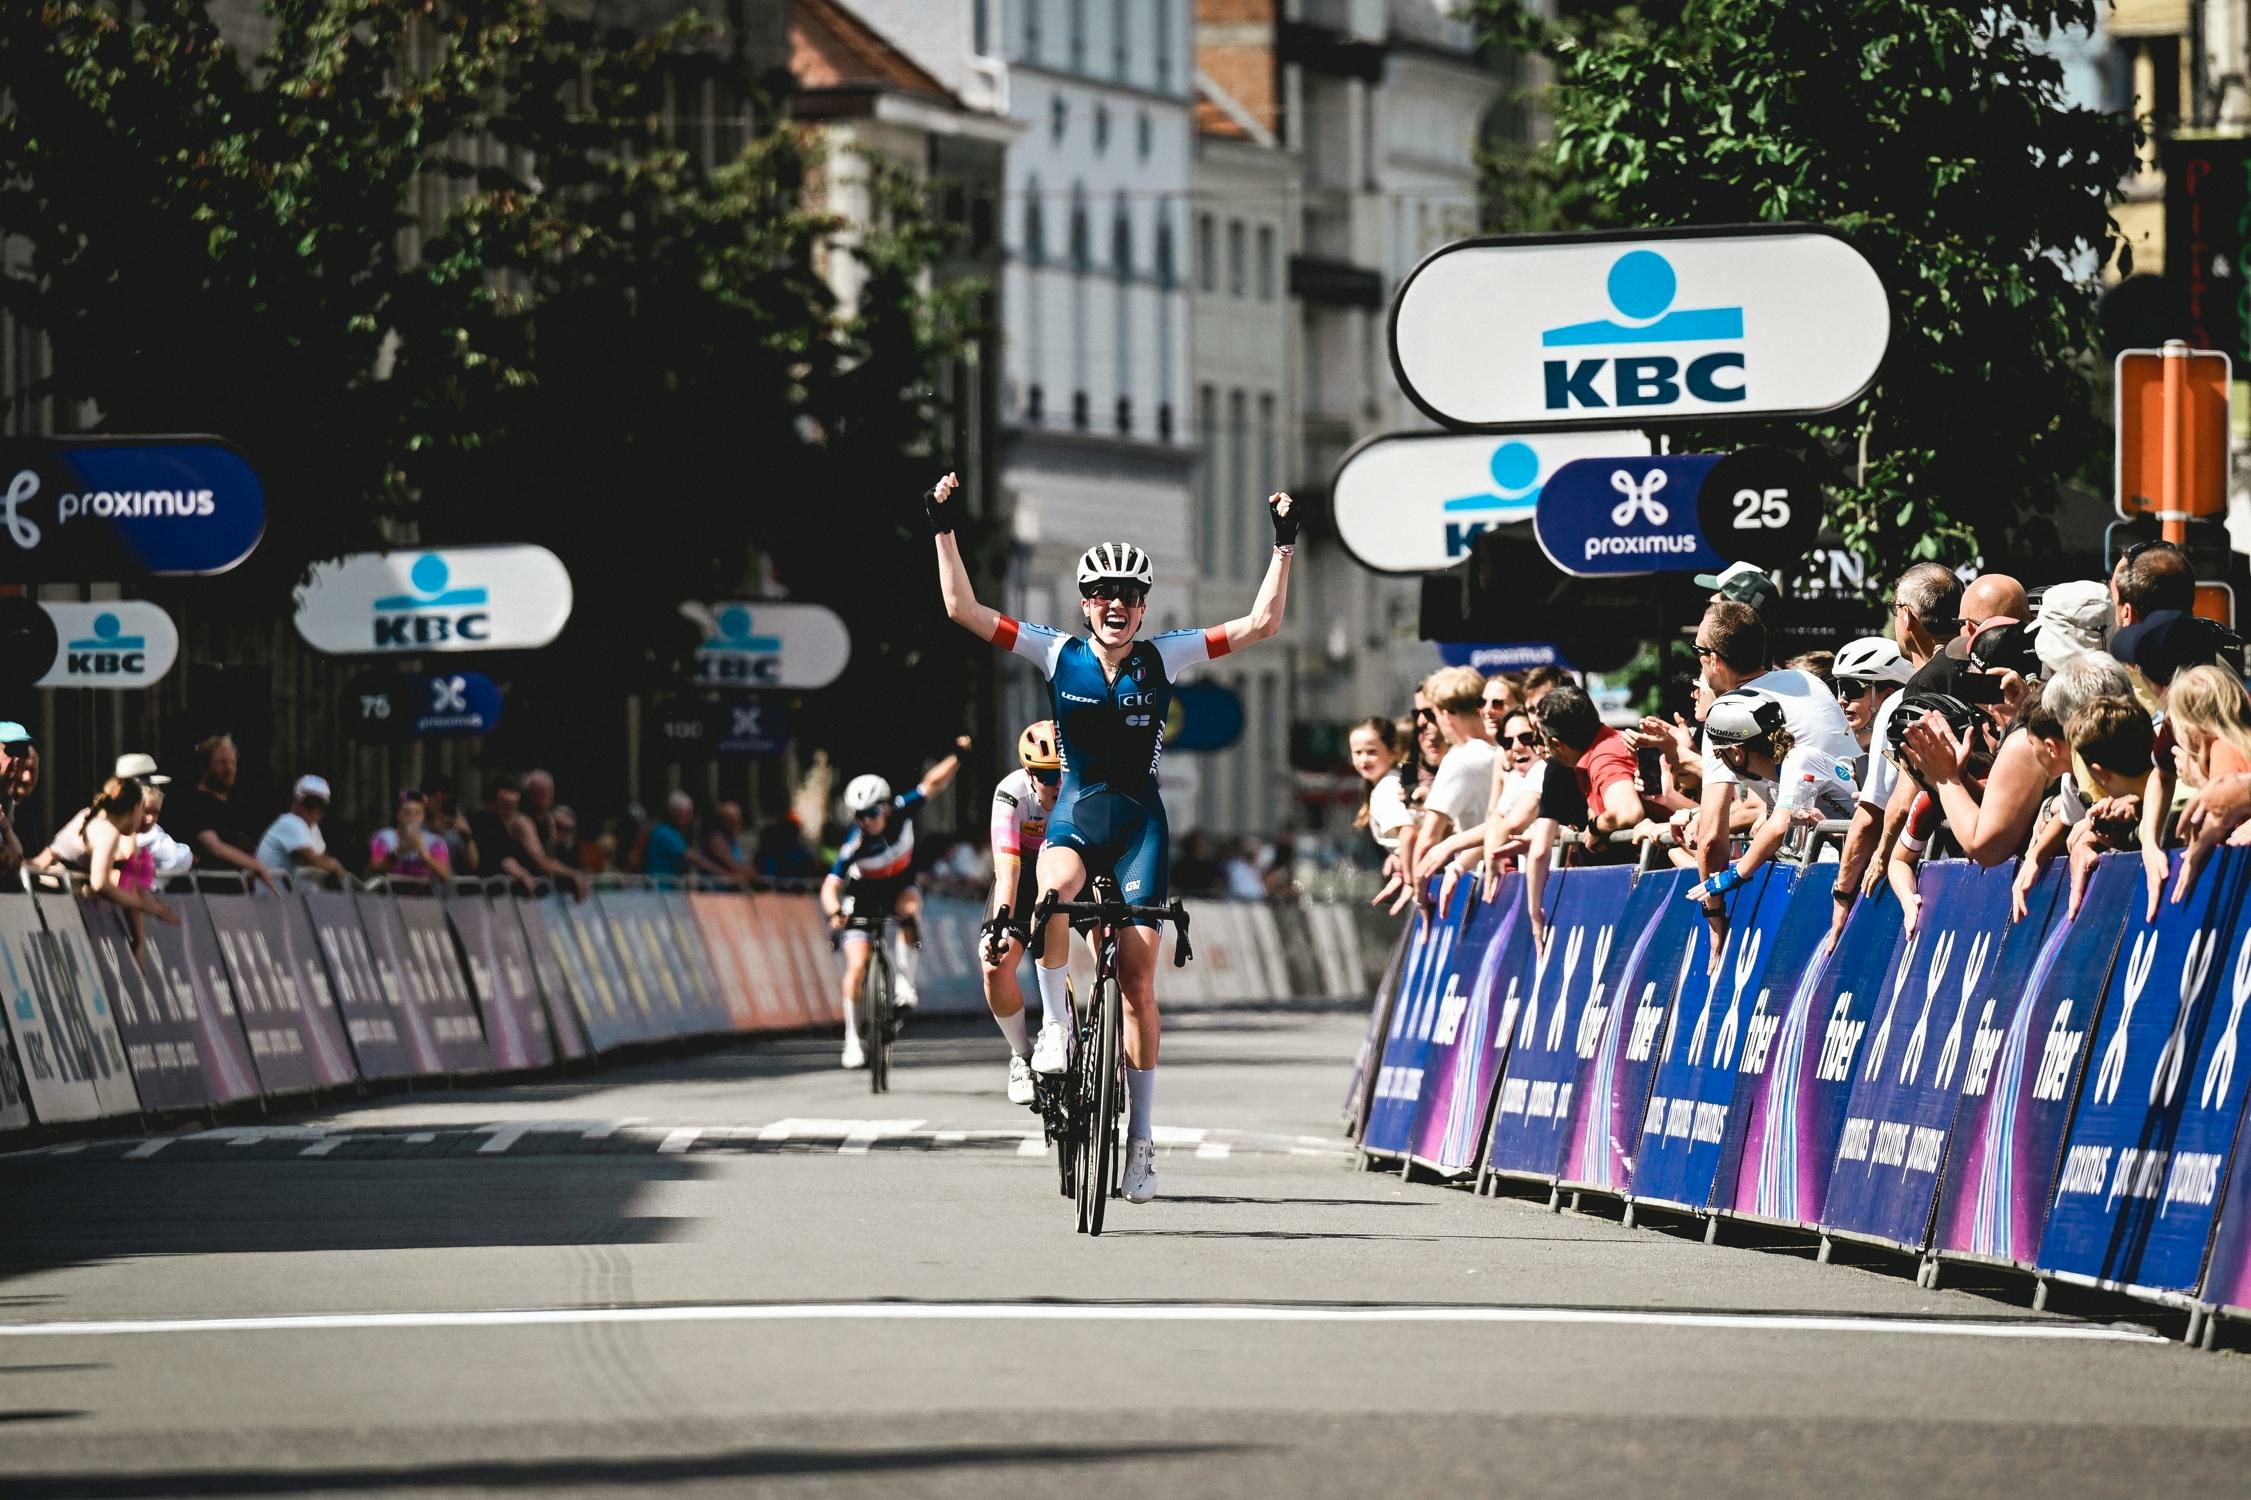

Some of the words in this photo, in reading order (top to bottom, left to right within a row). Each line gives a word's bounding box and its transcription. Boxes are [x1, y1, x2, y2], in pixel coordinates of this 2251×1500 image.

[1543, 352, 1746, 410] KBC
[58, 489, 215, 525] proximus
[1732, 489, 1790, 528] 25
[1585, 534, 1697, 561] proximus
[373, 613, 490, 647] KBC
[1471, 646, 1554, 667] proximus
[68, 653, 145, 673] KBC
[1061, 691, 1101, 705] LOOK
[1149, 719, 1166, 776] FRANCE
[1578, 982, 1608, 1060] fiber
[1625, 981, 1664, 1061] fiber
[1738, 987, 1780, 1075] fiber
[1815, 991, 1865, 1081] fiber
[1962, 998, 2004, 1096] fiber
[2033, 998, 2083, 1101] fiber
[2054, 1144, 2113, 1209] proximus
